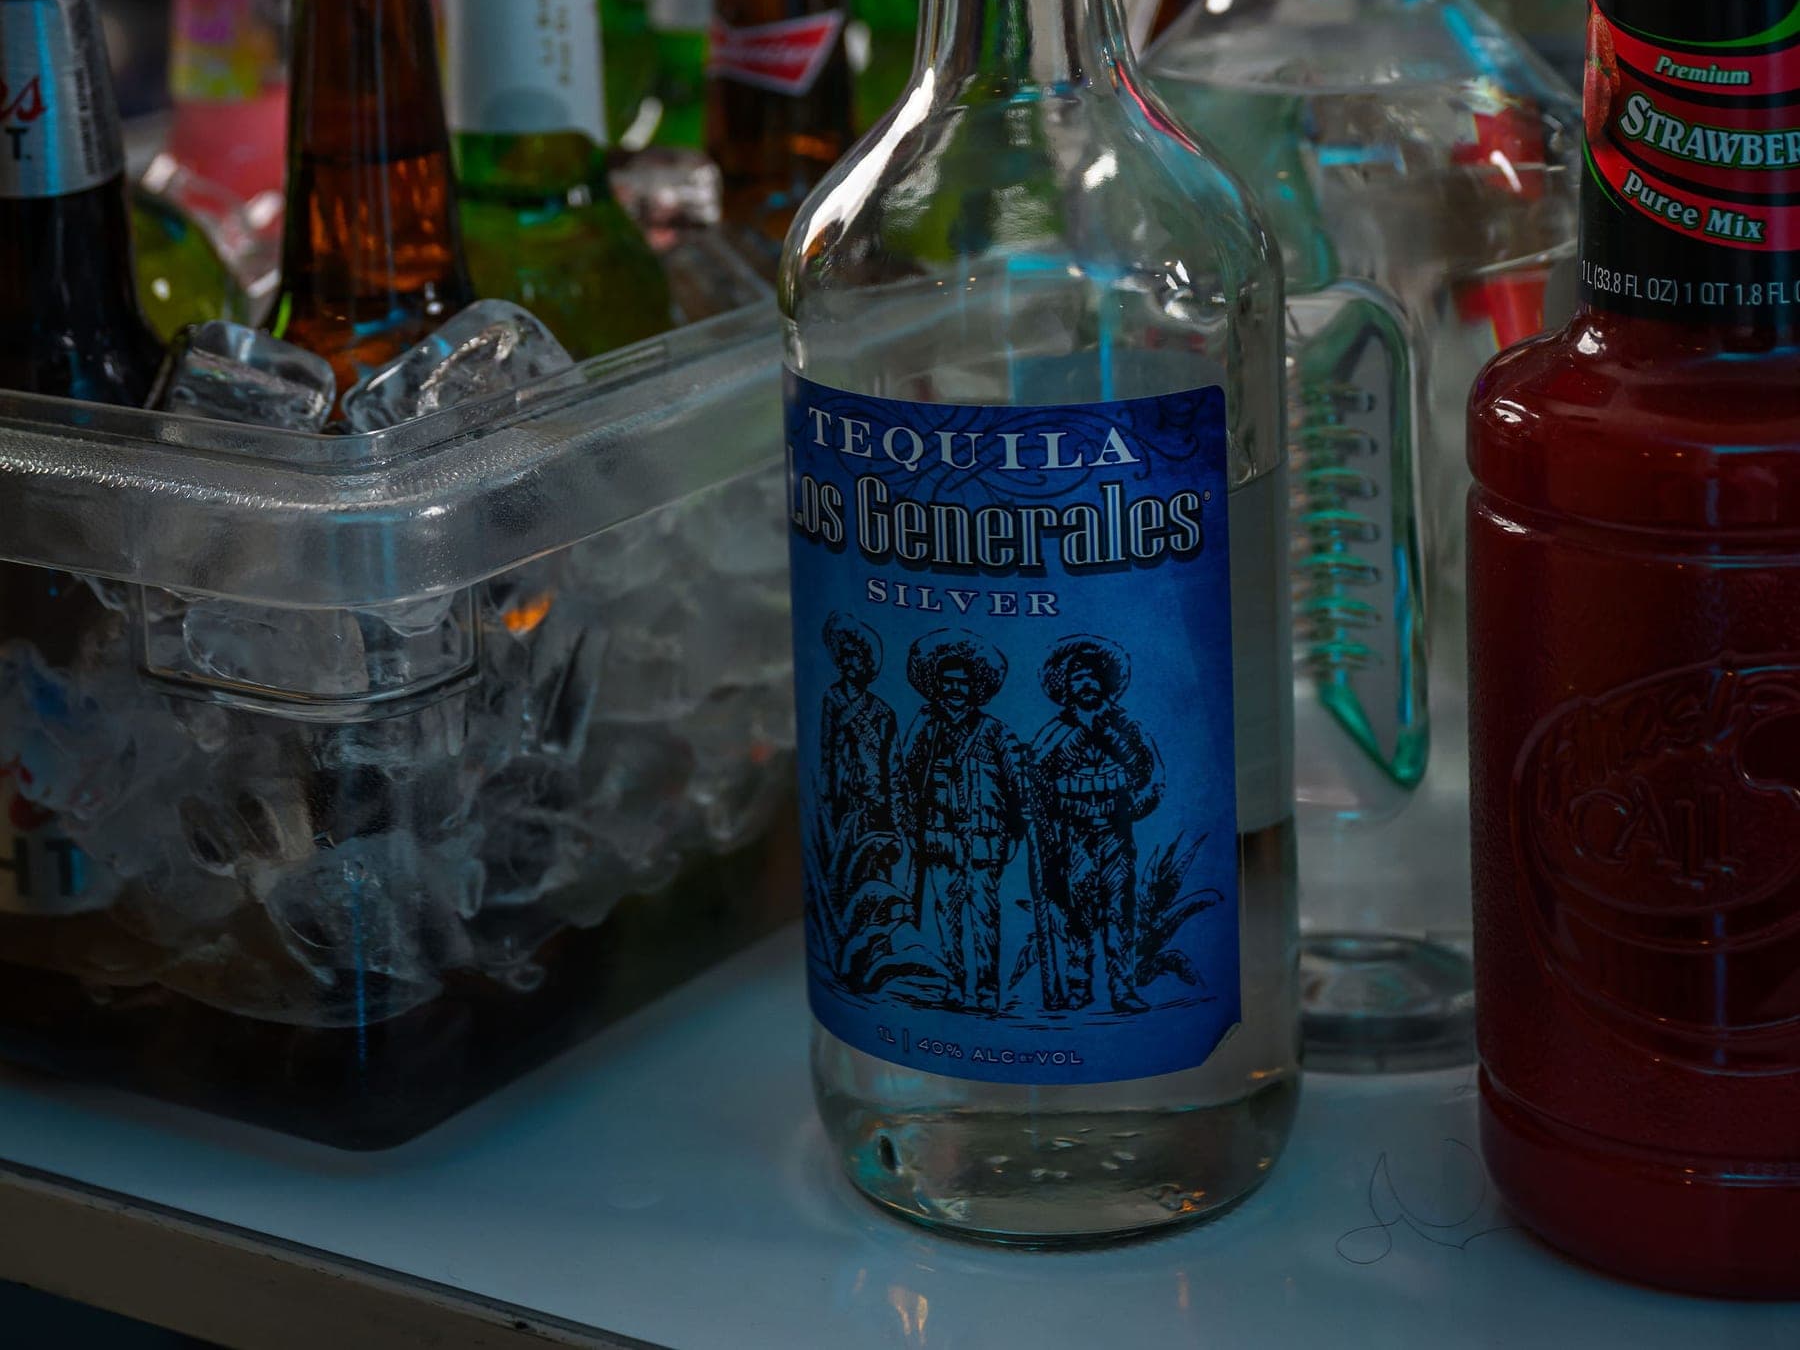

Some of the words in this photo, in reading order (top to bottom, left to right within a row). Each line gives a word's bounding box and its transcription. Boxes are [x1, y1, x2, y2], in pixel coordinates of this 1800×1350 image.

[1654, 54, 1752, 86] Premium
[1622, 171, 1699, 226] Puree
[1705, 208, 1765, 241] Mix
[1625, 273, 1643, 299] FL
[1647, 277, 1679, 306] OZ)
[1684, 283, 1692, 305] 1
[1701, 282, 1730, 306] QT
[1735, 284, 1762, 306] 1.8
[1767, 282, 1792, 305] FL
[807, 406, 1141, 472] TEQUILA
[856, 473, 1203, 570] Generales
[865, 578, 1060, 616] SILVER
[917, 1038, 963, 1059] 40%
[972, 1049, 1015, 1063] ALC
[1036, 1052, 1082, 1065] VOL
